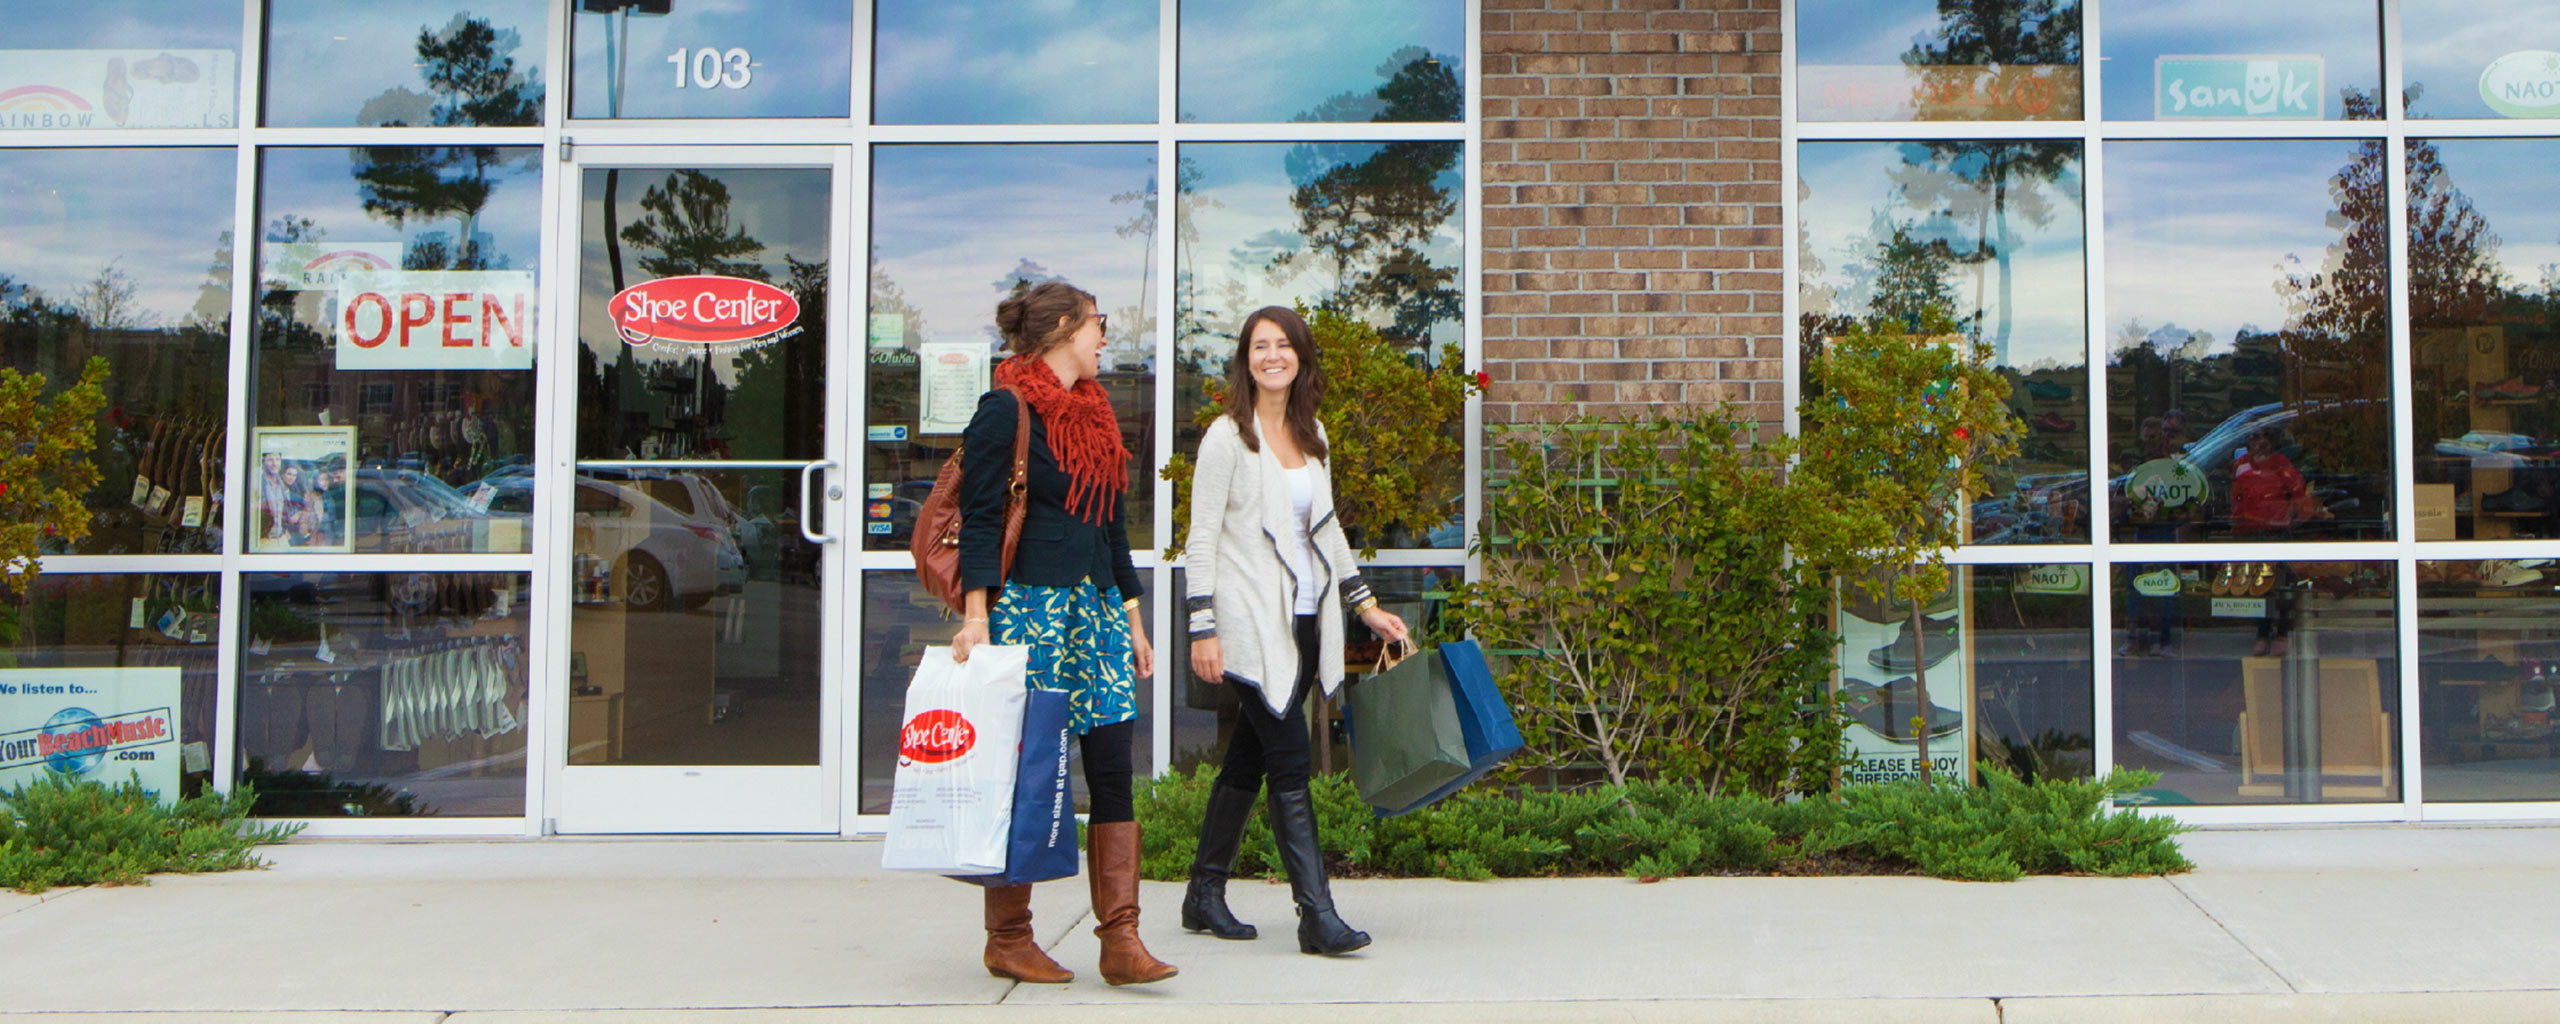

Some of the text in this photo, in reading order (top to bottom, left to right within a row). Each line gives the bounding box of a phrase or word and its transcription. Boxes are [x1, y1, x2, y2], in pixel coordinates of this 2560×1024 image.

[667, 47, 752, 89] 103
[625, 287, 782, 325] Shoe Center
[345, 292, 524, 348] OPEN
[2144, 484, 2191, 499] NAOT
[871, 524, 890, 532] VISA
[2031, 573, 2067, 585] NAOT
[2143, 579, 2169, 587] NAOT
[22, 684, 64, 694] listen
[114, 751, 155, 761] .com
[1851, 757, 1958, 772] PLEASE EJOY
[1048, 728, 1068, 848] more sizes at gap.com
